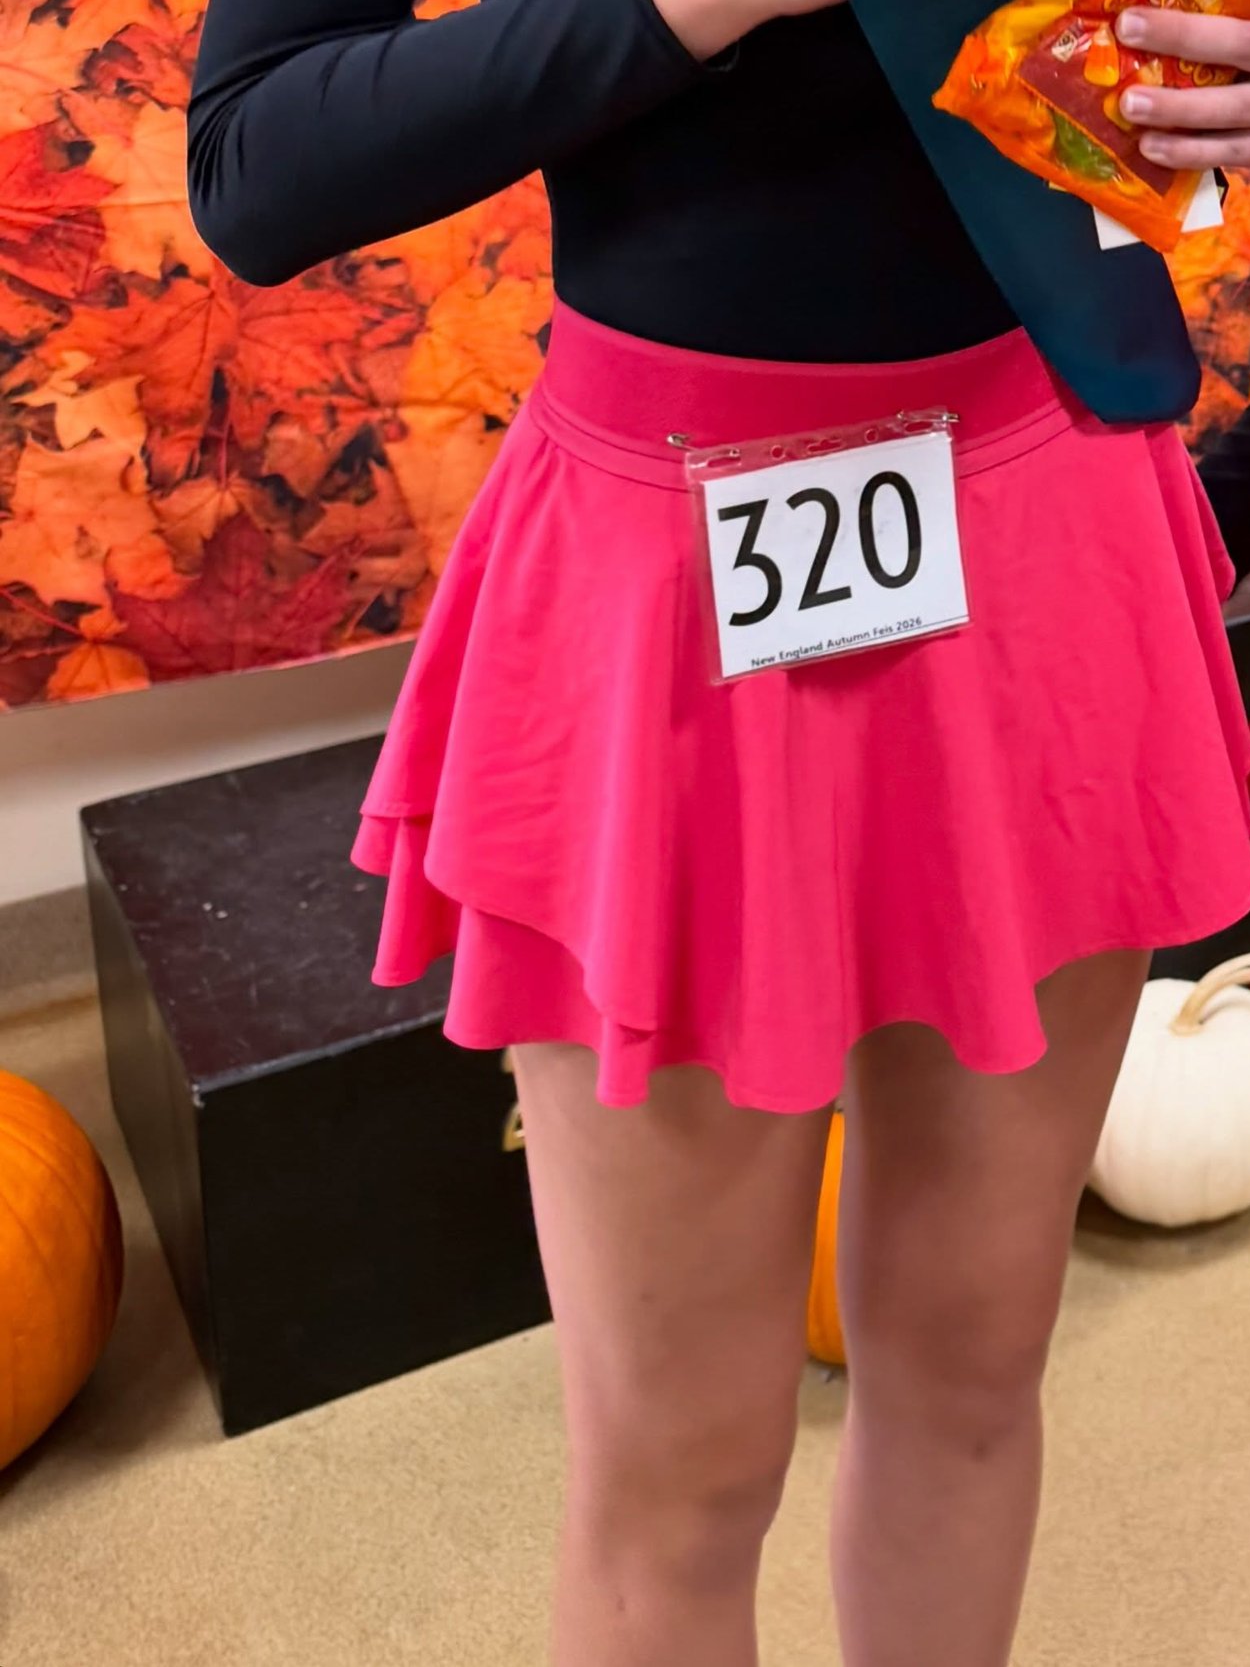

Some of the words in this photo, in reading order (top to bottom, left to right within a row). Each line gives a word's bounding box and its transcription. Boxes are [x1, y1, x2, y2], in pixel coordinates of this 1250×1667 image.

[717, 471, 922, 626] 320
[751, 655, 776, 667] New
[779, 641, 823, 659] England
[827, 631, 871, 649] Autumn
[873, 624, 893, 637] Feis
[896, 616, 922, 631] 2026
